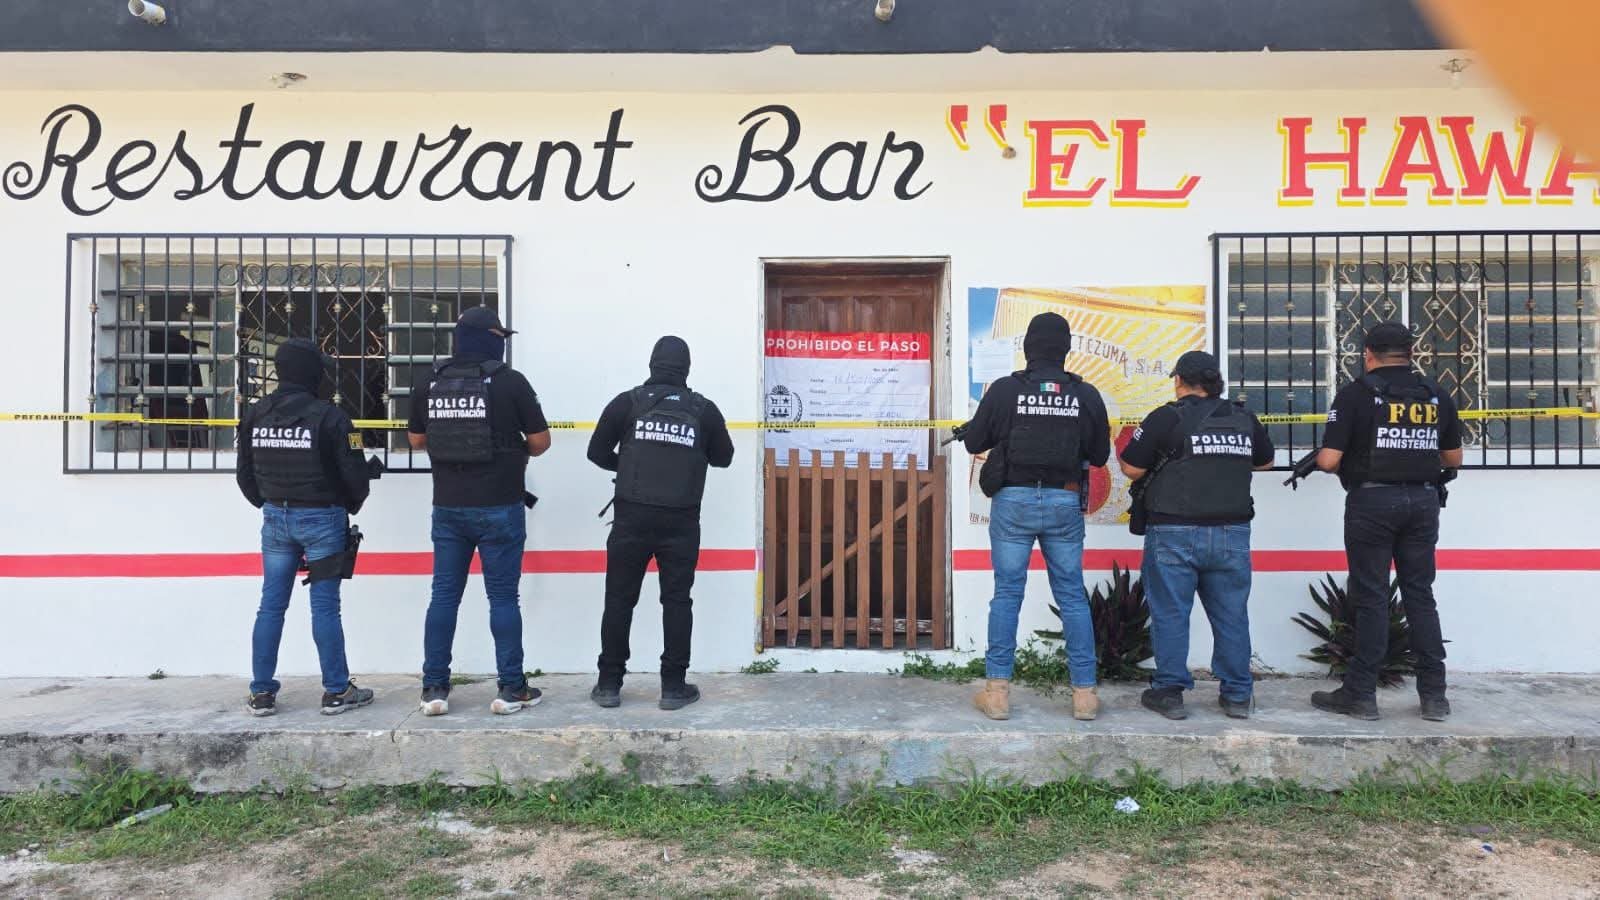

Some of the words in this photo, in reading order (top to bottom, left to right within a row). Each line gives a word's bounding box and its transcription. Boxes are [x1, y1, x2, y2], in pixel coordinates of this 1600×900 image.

[2, 102, 635, 217] Restaurant
[695, 104, 933, 203] Bar
[767, 338, 852, 352] PROHIBIDO
[857, 340, 876, 352] EL
[880, 340, 920, 352] PASO
[428, 396, 486, 409] POLICÍA
[1016, 394, 1080, 408] POLICÍA
[428, 409, 436, 418] DE
[436, 408, 486, 419] INVESTIGACIÓN
[1016, 406, 1027, 415] DE
[1028, 406, 1080, 417] INVESTIGACIÓN
[1388, 403, 1439, 424] FGE
[252, 427, 312, 439] POLICÍA
[635, 420, 696, 438] POLICÍA
[1376, 426, 1439, 439] POLICÍA
[252, 439, 259, 448] DE
[260, 439, 312, 449] INVESTIGACIÓN
[635, 430, 645, 440] DE
[645, 431, 695, 448] INVESTIGACIÓN
[1191, 434, 1252, 447] POLICÍA
[1376, 438, 1439, 450] MINISTERIAL
[1192, 446, 1204, 455] DE
[1204, 445, 1252, 456] INVESTIGACIÓN
